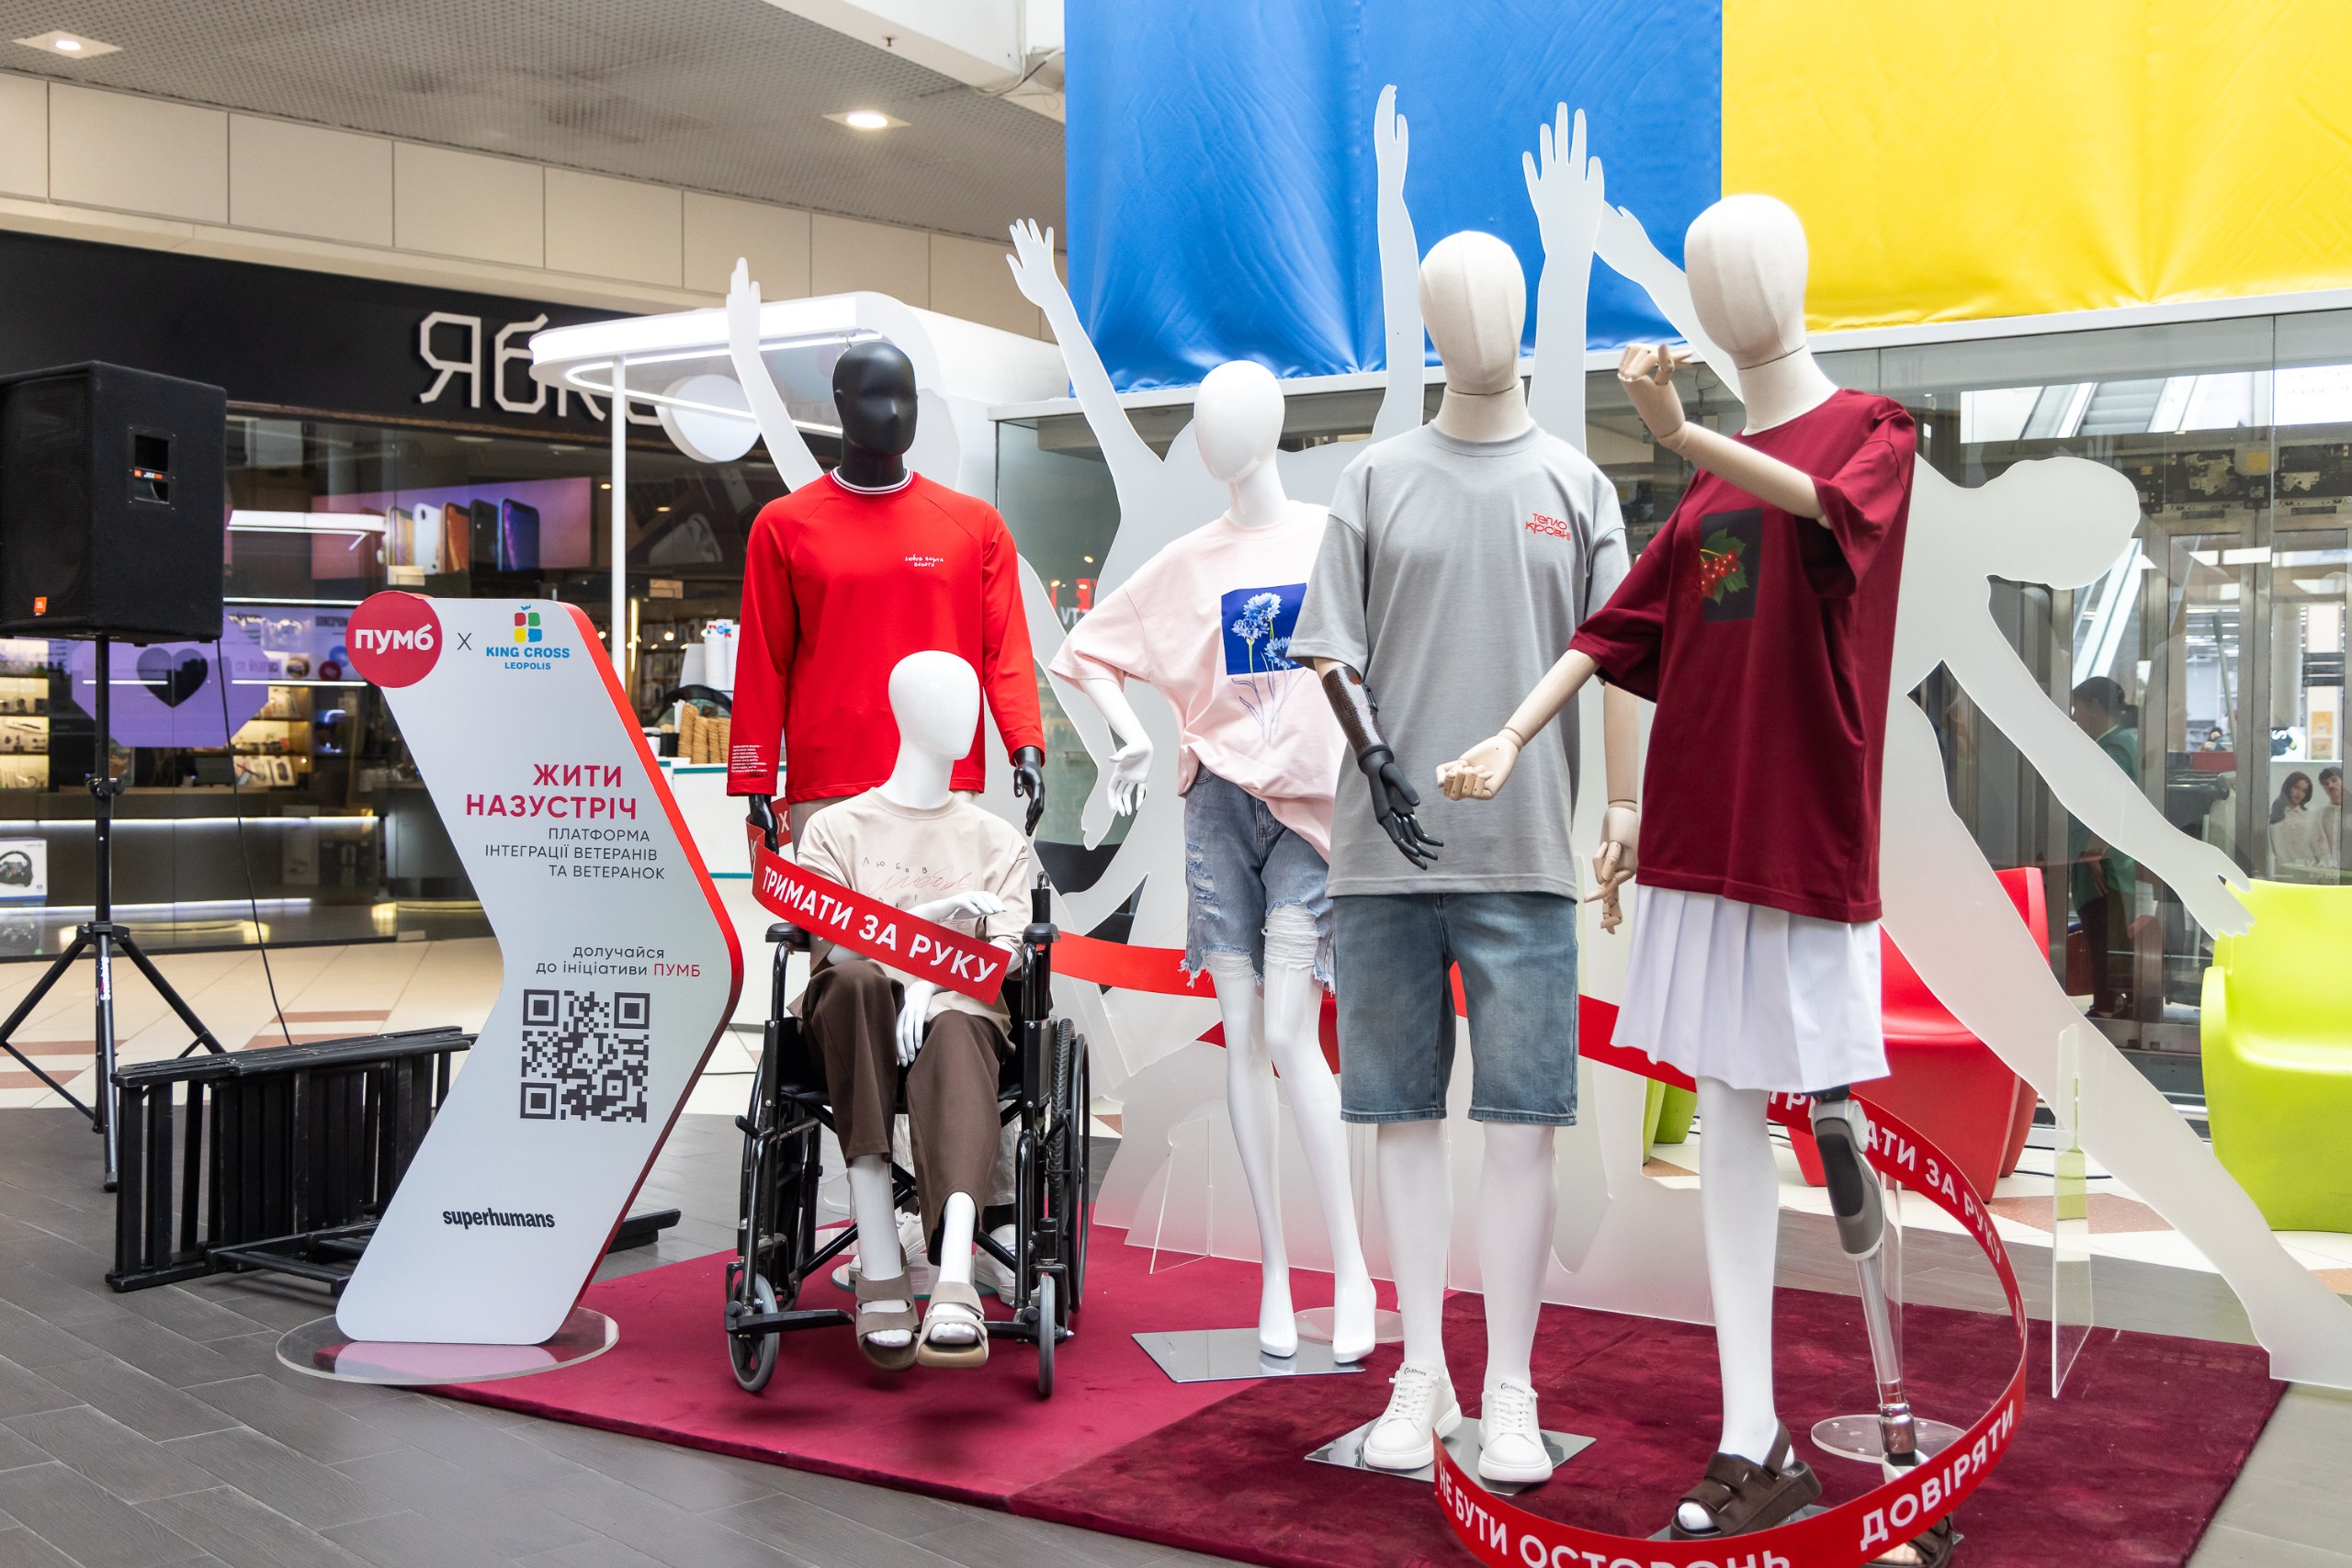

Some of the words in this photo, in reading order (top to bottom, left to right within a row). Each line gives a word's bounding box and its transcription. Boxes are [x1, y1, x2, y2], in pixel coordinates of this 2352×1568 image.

[420, 310, 662, 426] Яб
[486, 646, 520, 658] KING
[524, 647, 571, 659] CROSS
[504, 661, 551, 671] LEOPOLIS
[532, 763, 622, 788] ЖИТИ
[466, 794, 637, 820] НАЗУСТРІЧ
[548, 828, 650, 842] ПЛАТФОРМА
[485, 843, 569, 860] ІНТЕГРАЦІЇ
[574, 847, 658, 861] ВЕТЕРАНІВ
[548, 864, 568, 877] ТА
[573, 865, 665, 879] ВЕТЕРАНОК
[762, 865, 854, 931] ТРИМАТИ
[858, 914, 898, 952] ЗА
[909, 933, 999, 984] РУКУ
[572, 946, 664, 960] долучайся
[536, 963, 557, 975] до
[563, 961, 648, 976] ініціативи
[653, 964, 701, 977] ПУМБ
[442, 1207, 556, 1230] superhumans
[1925, 1157, 1958, 1205] ЗА
[1963, 1190, 2000, 1265] РУКУ
[1860, 1399, 2014, 1552] ДОВІРЯТИ
[1439, 1460, 1453, 1507] НЕ
[1454, 1485, 1508, 1556] БУТИ
